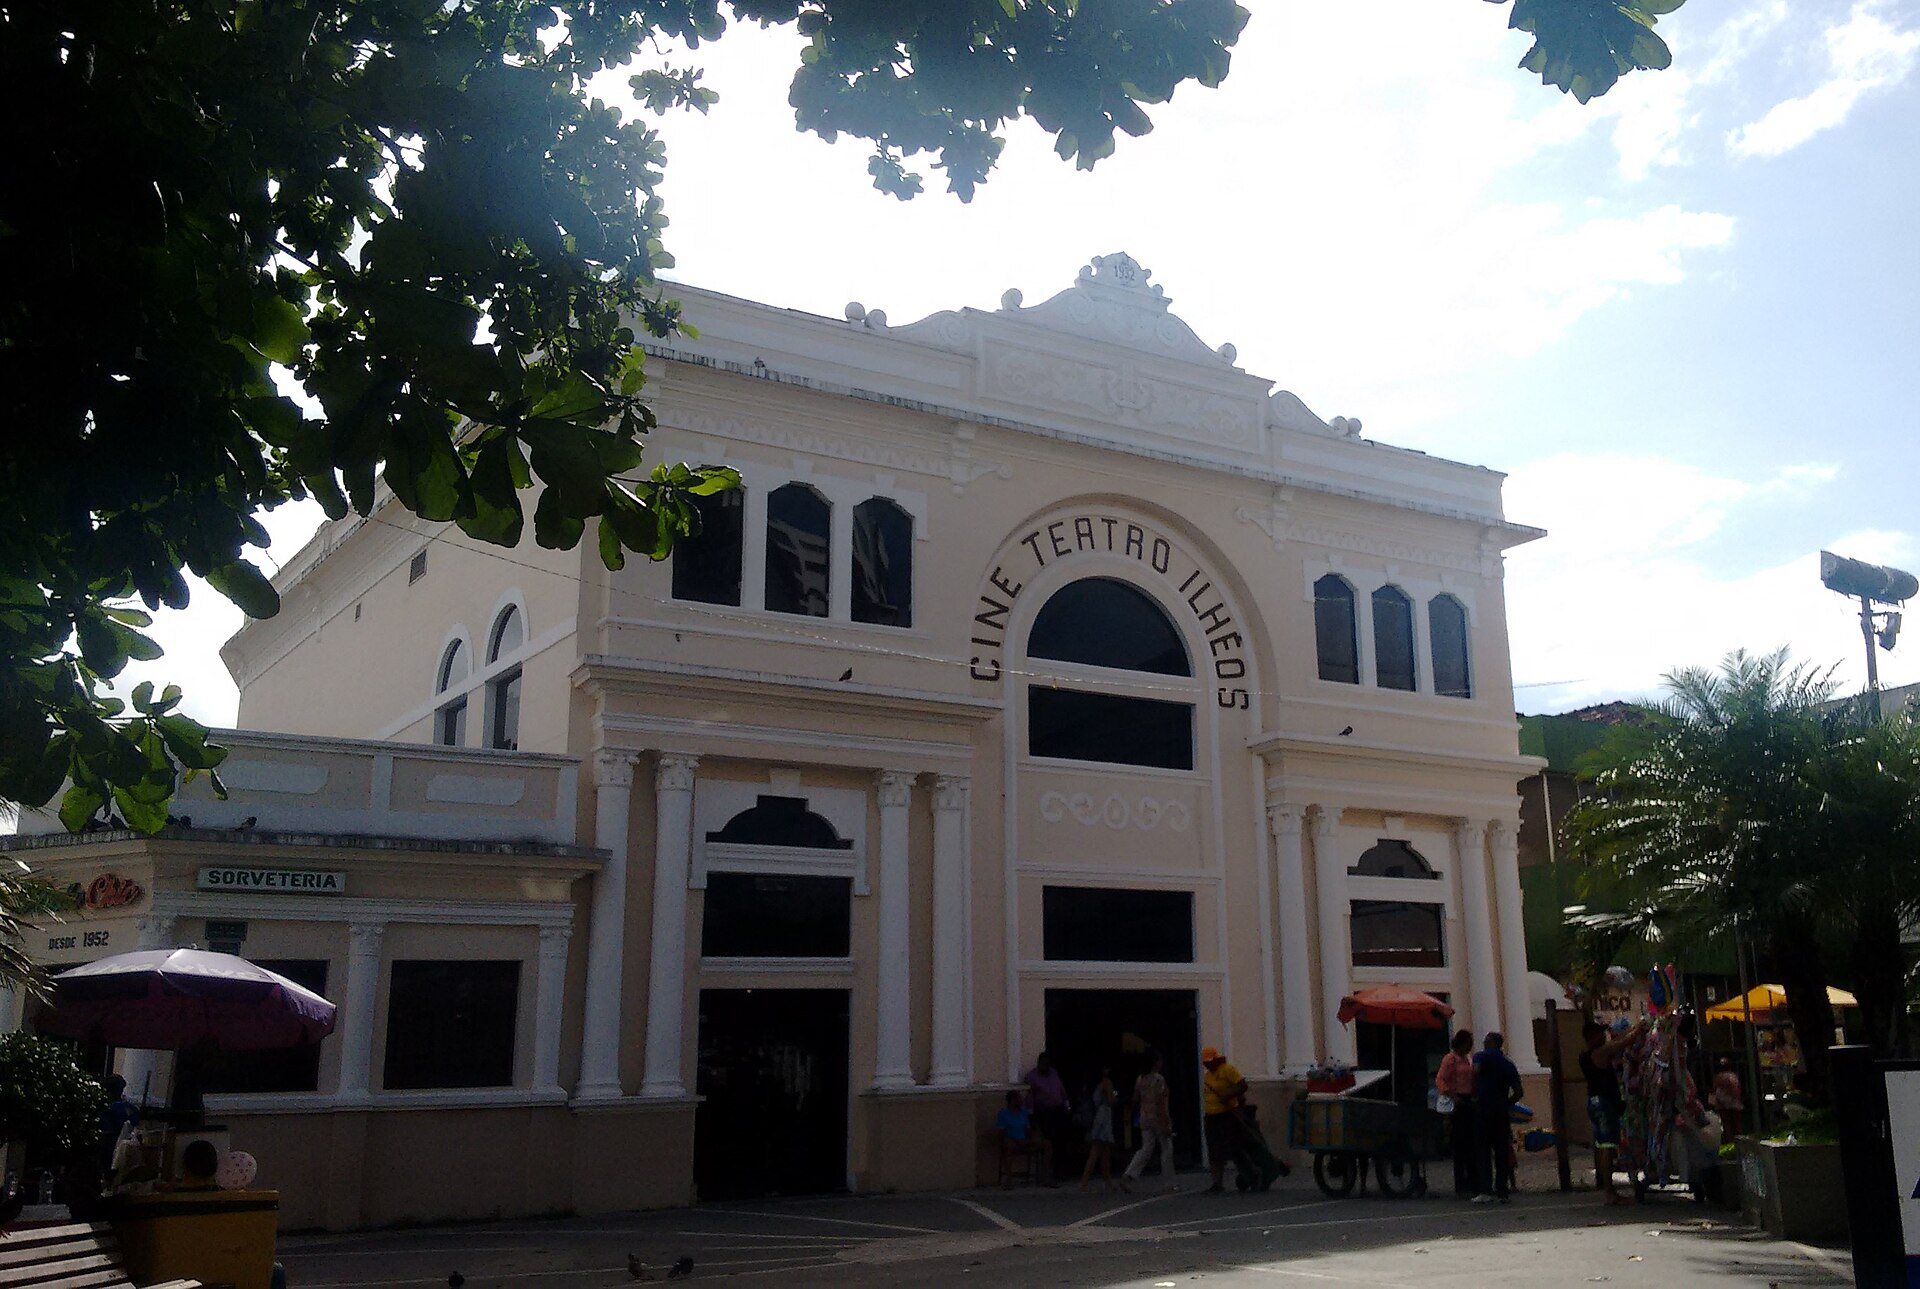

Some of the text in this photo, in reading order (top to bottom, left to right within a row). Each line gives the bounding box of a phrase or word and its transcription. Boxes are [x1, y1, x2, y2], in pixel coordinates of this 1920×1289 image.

[970, 517, 1250, 711] CINE TEATRO ILHÉOS
[208, 870, 337, 888] SORVETERIA
[48, 931, 110, 950] DESDE 1952
